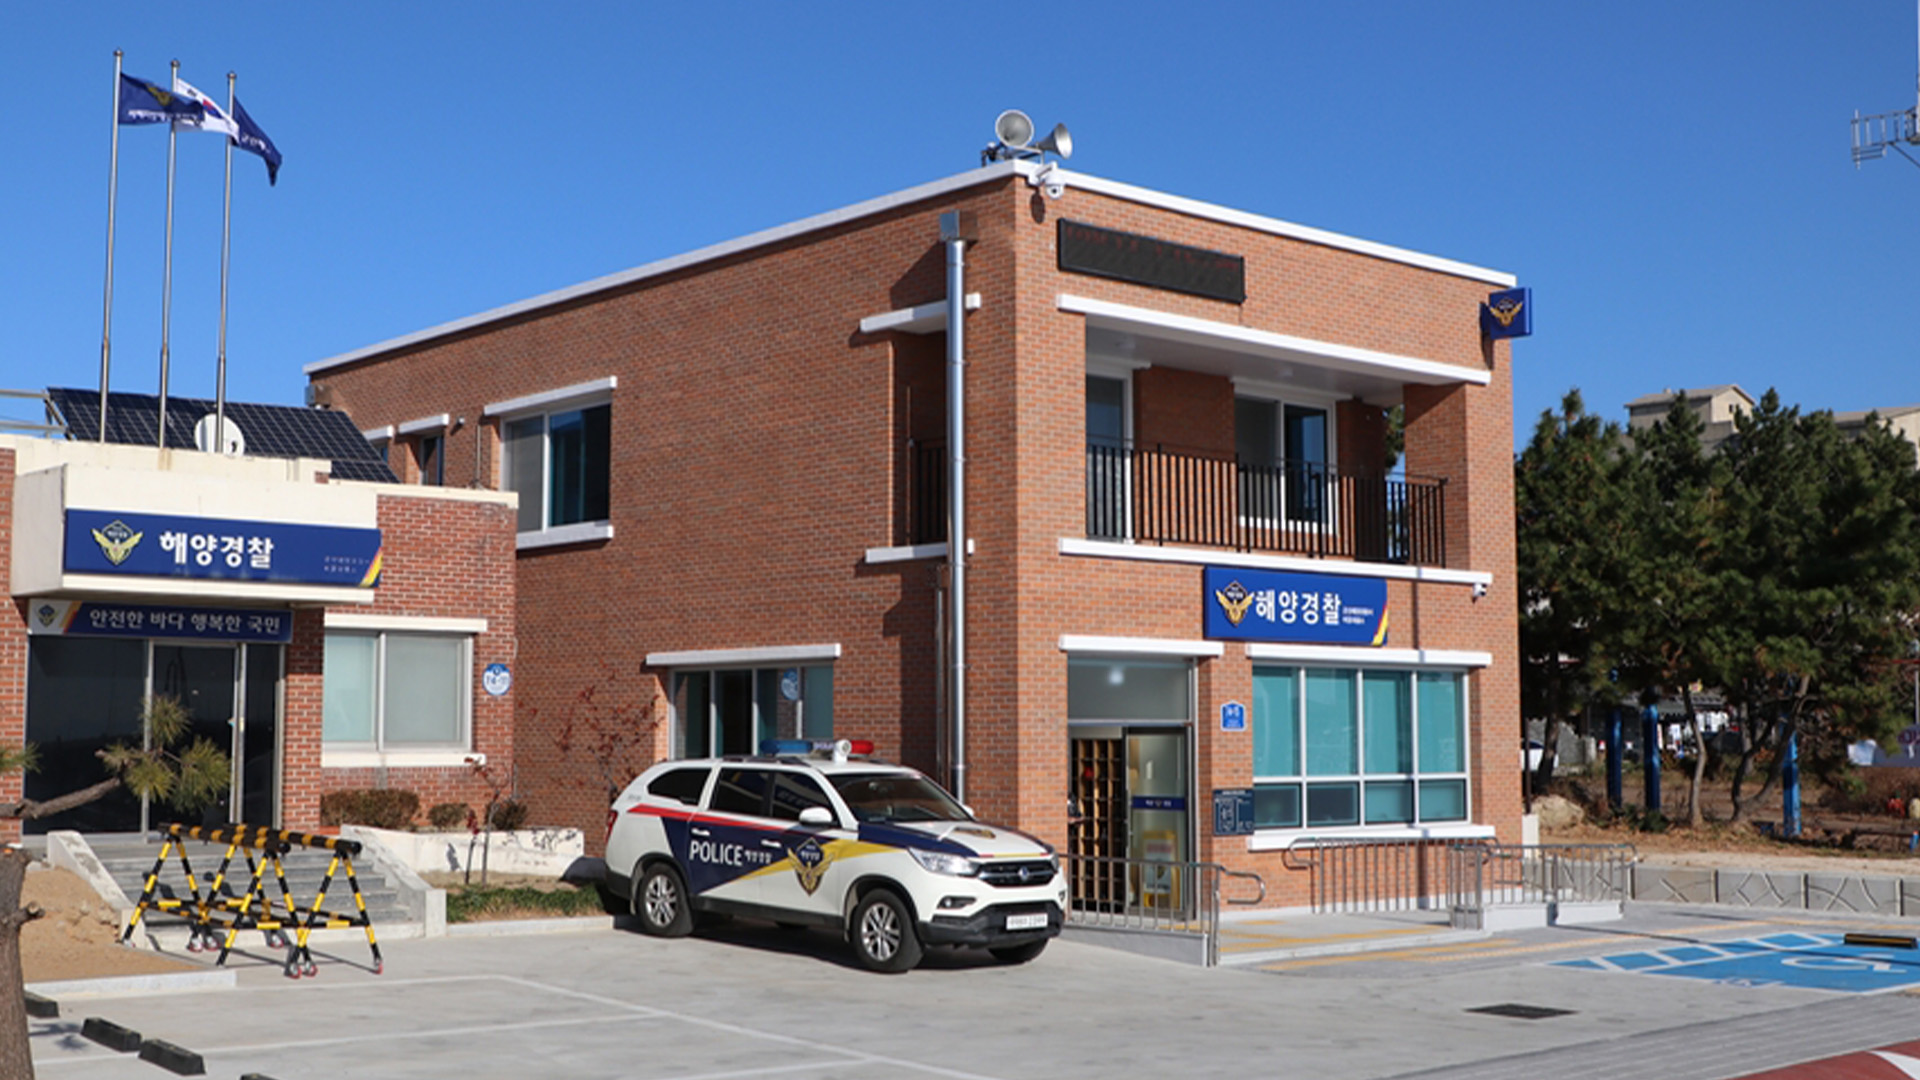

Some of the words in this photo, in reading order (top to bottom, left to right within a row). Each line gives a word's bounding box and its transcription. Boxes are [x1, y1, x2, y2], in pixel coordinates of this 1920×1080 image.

[159, 530, 274, 569] 해양경찰
[89, 608, 144, 629] 안전한
[150, 611, 185, 631] 바다
[190, 612, 242, 633] 행복한
[247, 615, 280, 635] 국민
[1255, 589, 1341, 625] 해양경찰
[689, 840, 744, 866] POLICE
